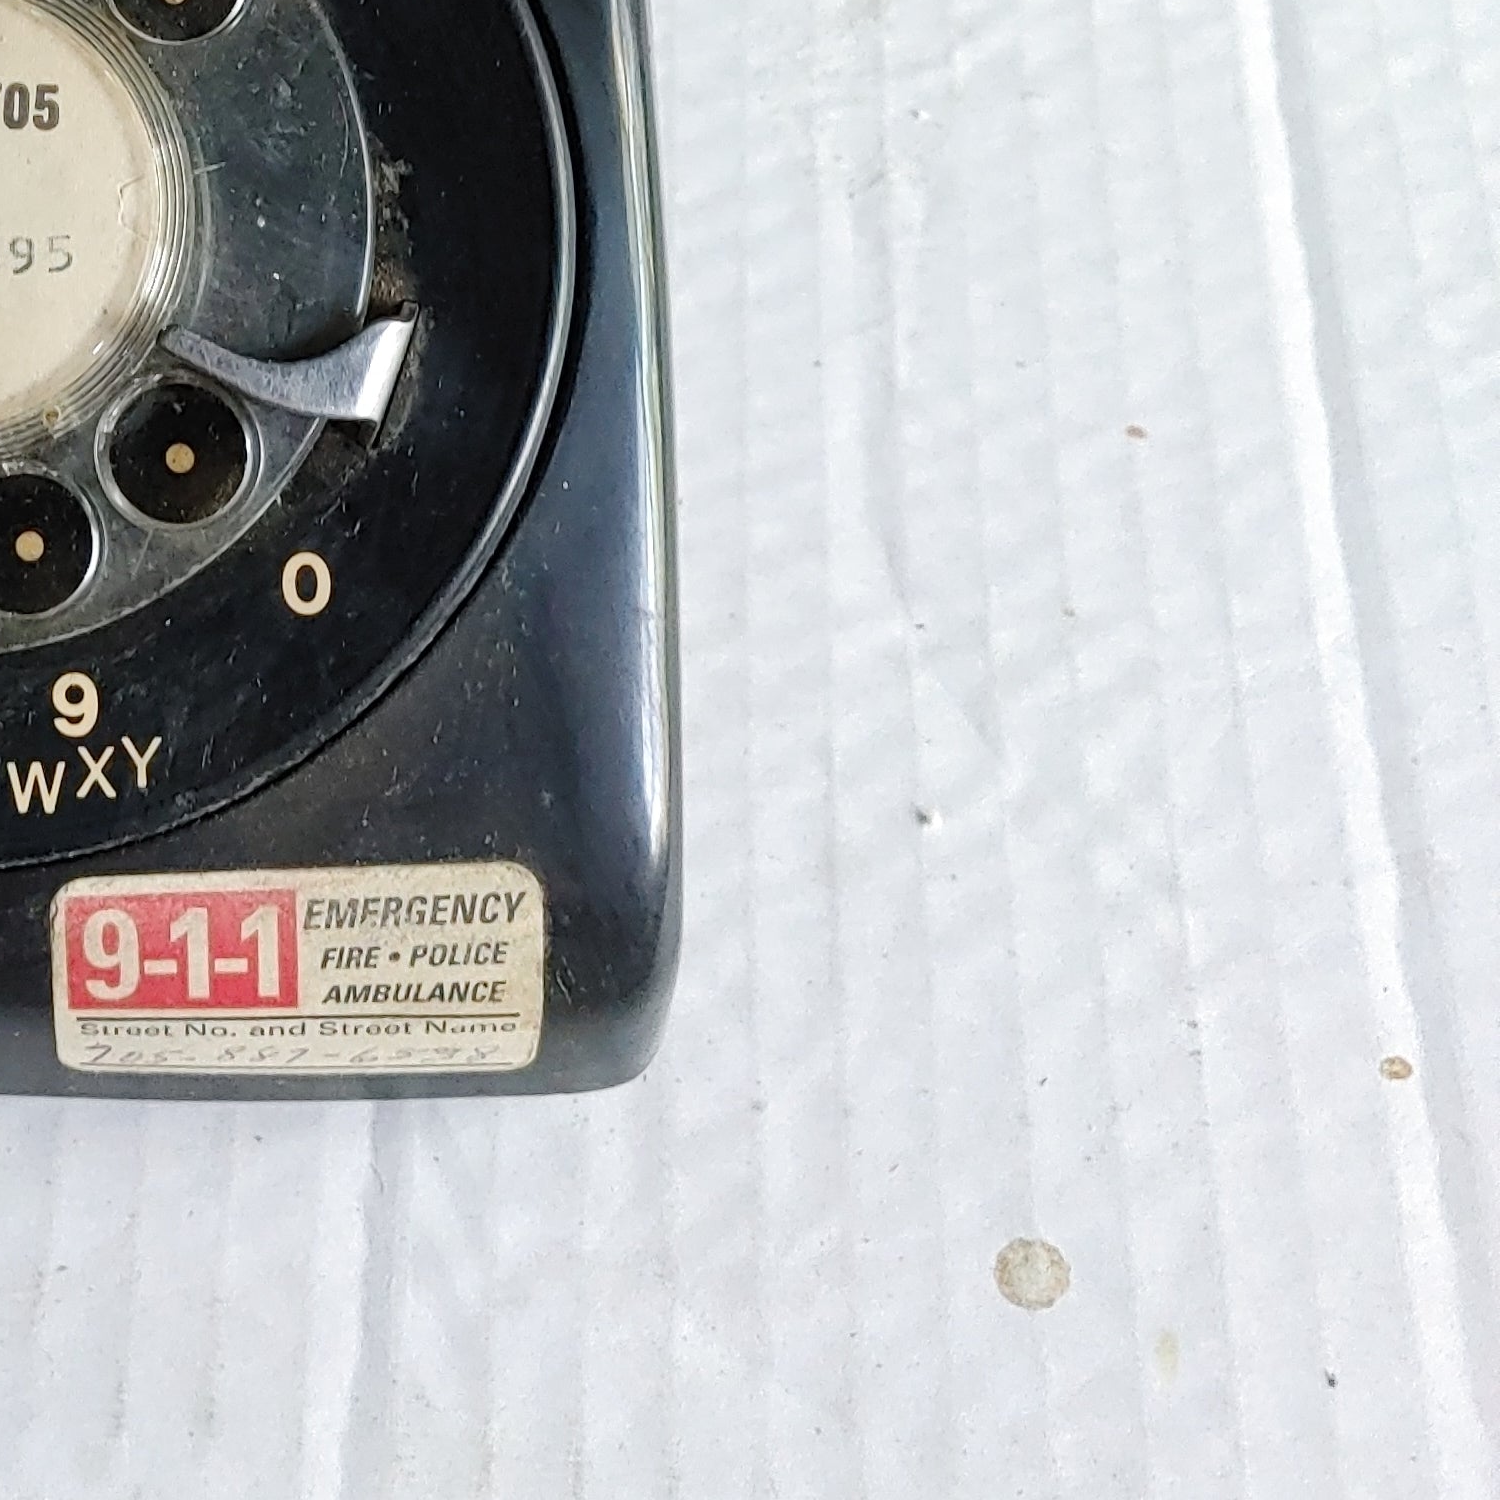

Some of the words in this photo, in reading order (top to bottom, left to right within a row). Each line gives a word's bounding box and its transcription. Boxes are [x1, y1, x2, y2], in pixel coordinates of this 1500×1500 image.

[281, 551, 332, 616] 0
[52, 671, 99, 738] 9
[7, 735, 162, 815] WXY
[303, 891, 527, 931] EMERGENCY
[83, 905, 281, 1001] 9-1-1
[320, 946, 382, 970] FIRE
[408, 941, 510, 968] POLICE
[321, 979, 508, 1005] AMBULANCE
[80, 1020, 173, 1038] Street
[184, 1021, 237, 1038] No.
[249, 1020, 307, 1038] and
[319, 1020, 412, 1037] Street
[424, 1018, 517, 1035] Name
